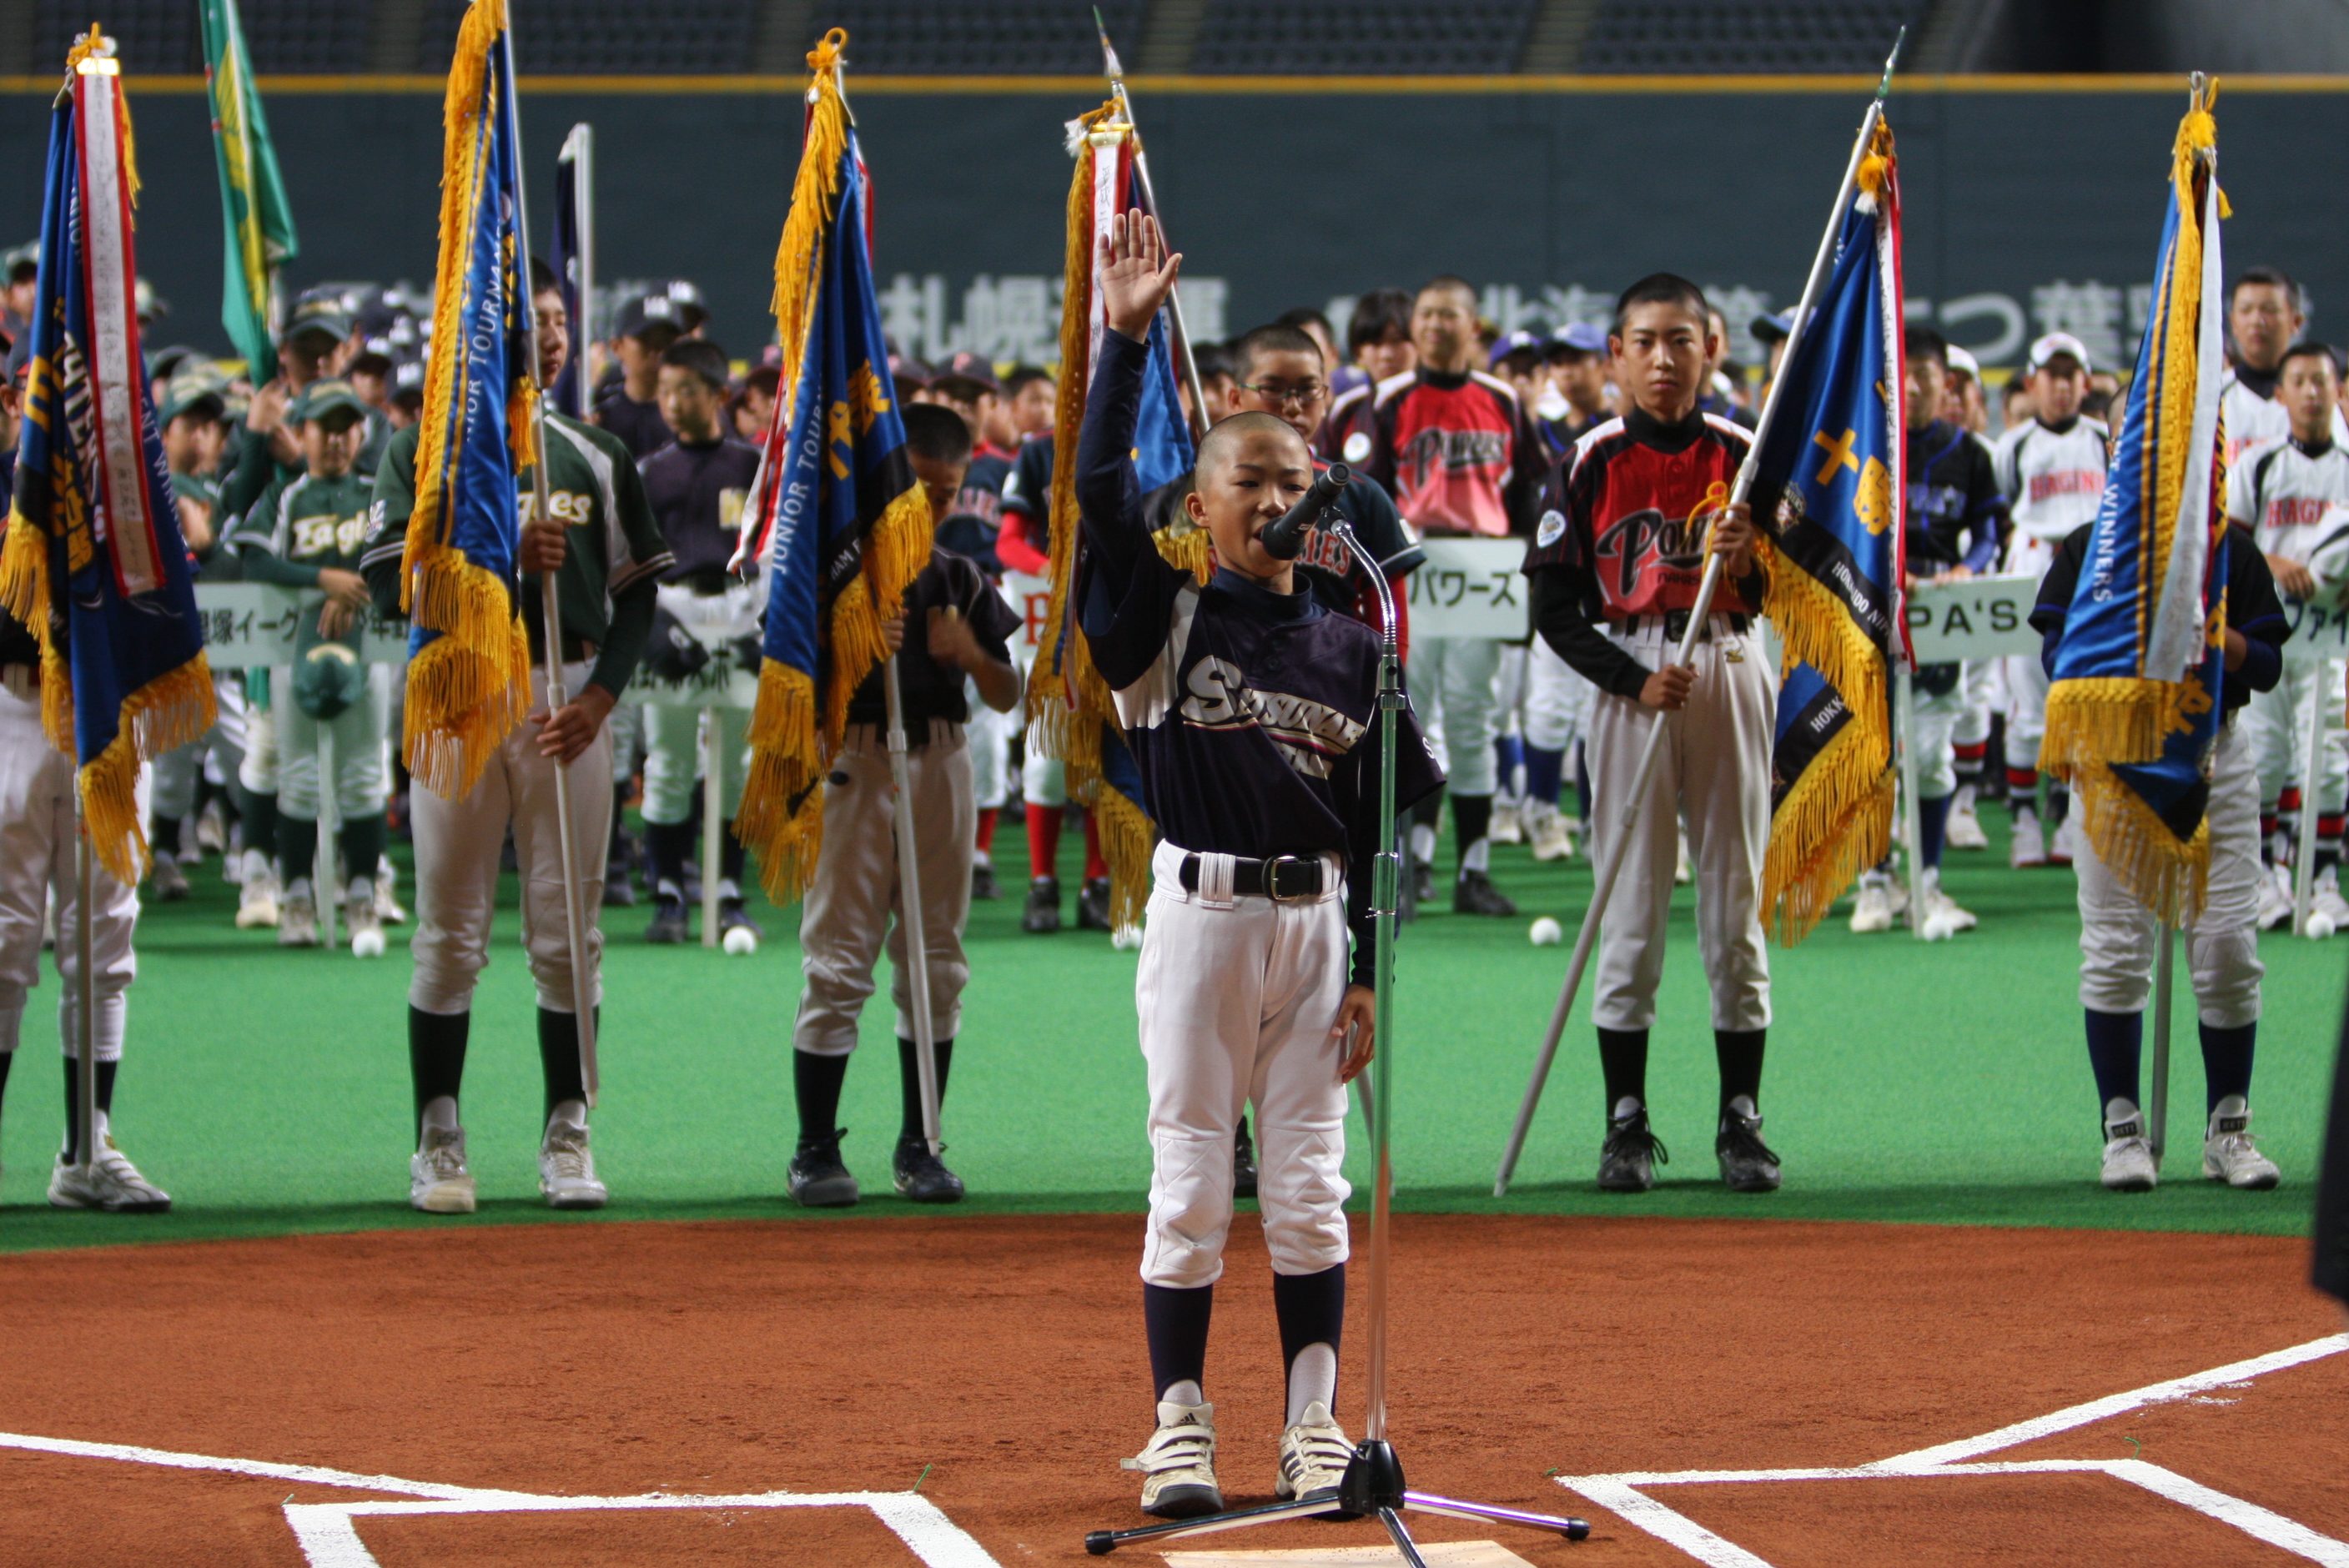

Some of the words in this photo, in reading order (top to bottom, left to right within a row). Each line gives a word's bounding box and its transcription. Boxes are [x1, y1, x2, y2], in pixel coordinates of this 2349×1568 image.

[772, 481, 809, 575] JUNIOR
[795, 379, 823, 471] TOUR
[1294, 528, 1352, 576] IES
[1594, 506, 1714, 599] POW
[2093, 483, 2120, 604] WINNERS
